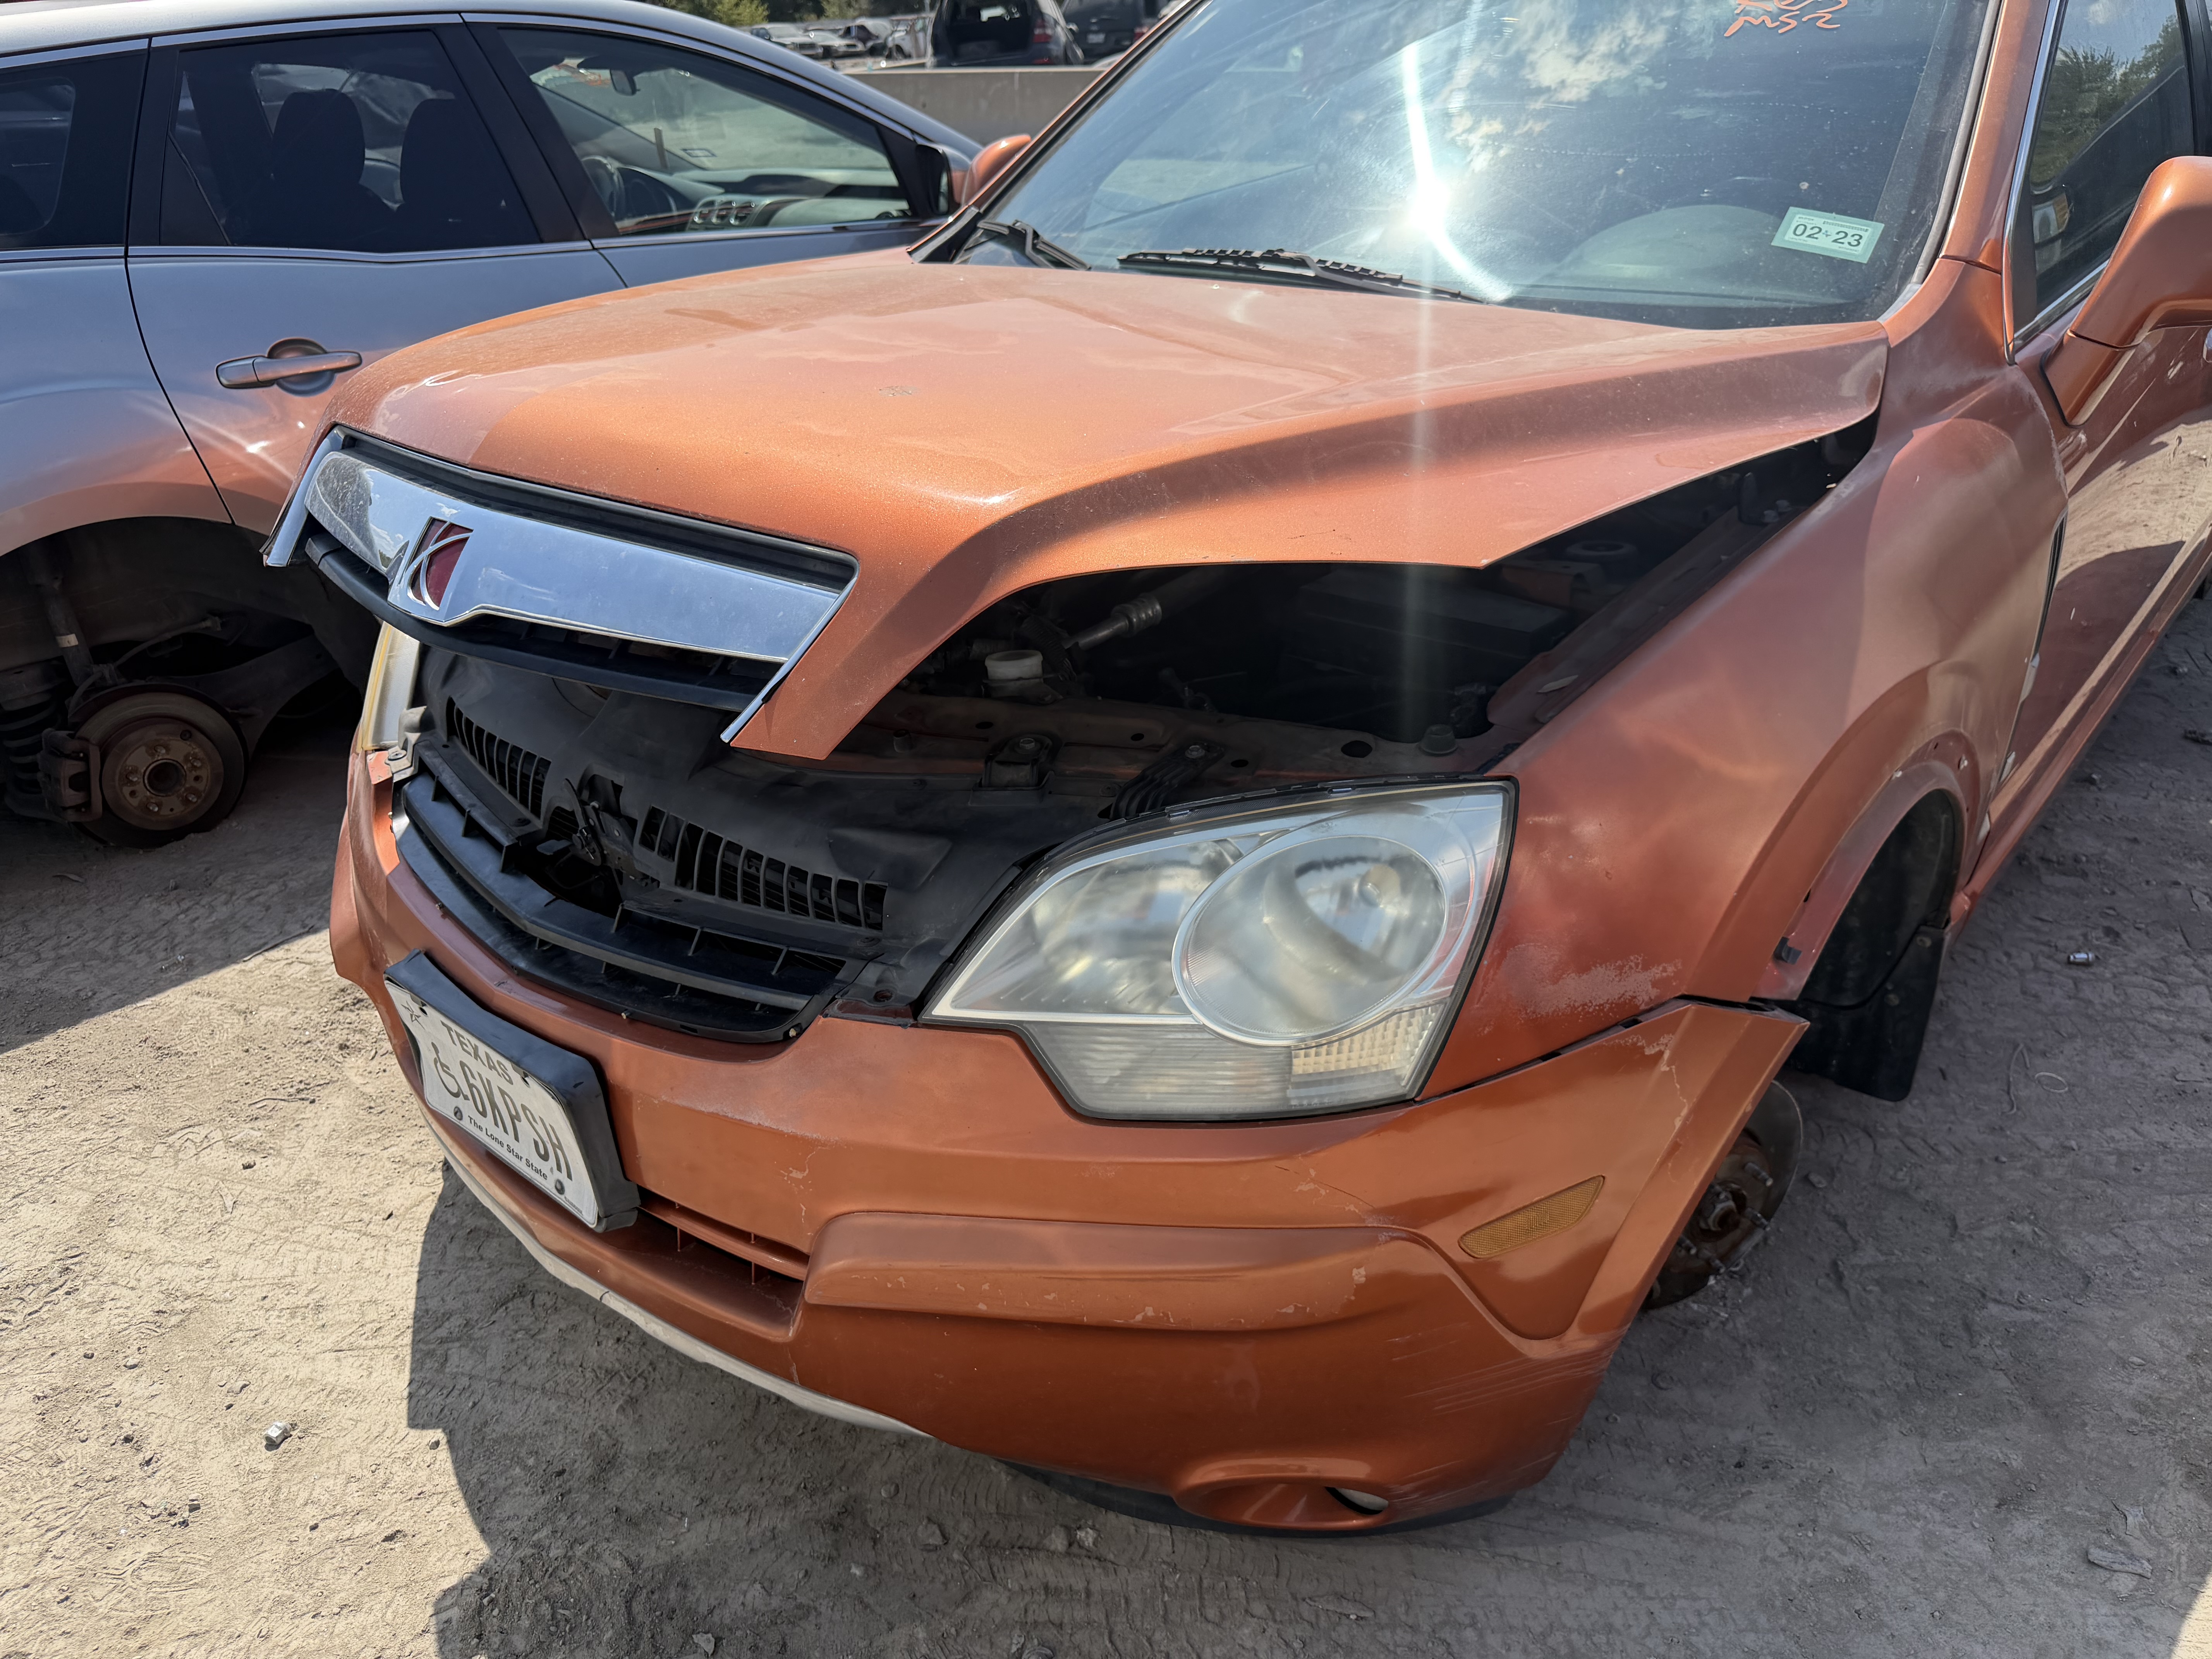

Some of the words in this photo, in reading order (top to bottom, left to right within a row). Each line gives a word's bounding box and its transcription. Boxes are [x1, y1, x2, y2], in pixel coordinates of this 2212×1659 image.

[1793, 223, 1822, 240] 02
[1831, 230, 1863, 247] 23
[440, 1020, 514, 1085] TEXAS
[468, 1115, 483, 1132] The
[485, 1127, 504, 1148] Lone
[506, 1144, 524, 1162] Star
[525, 1158, 548, 1180] State
